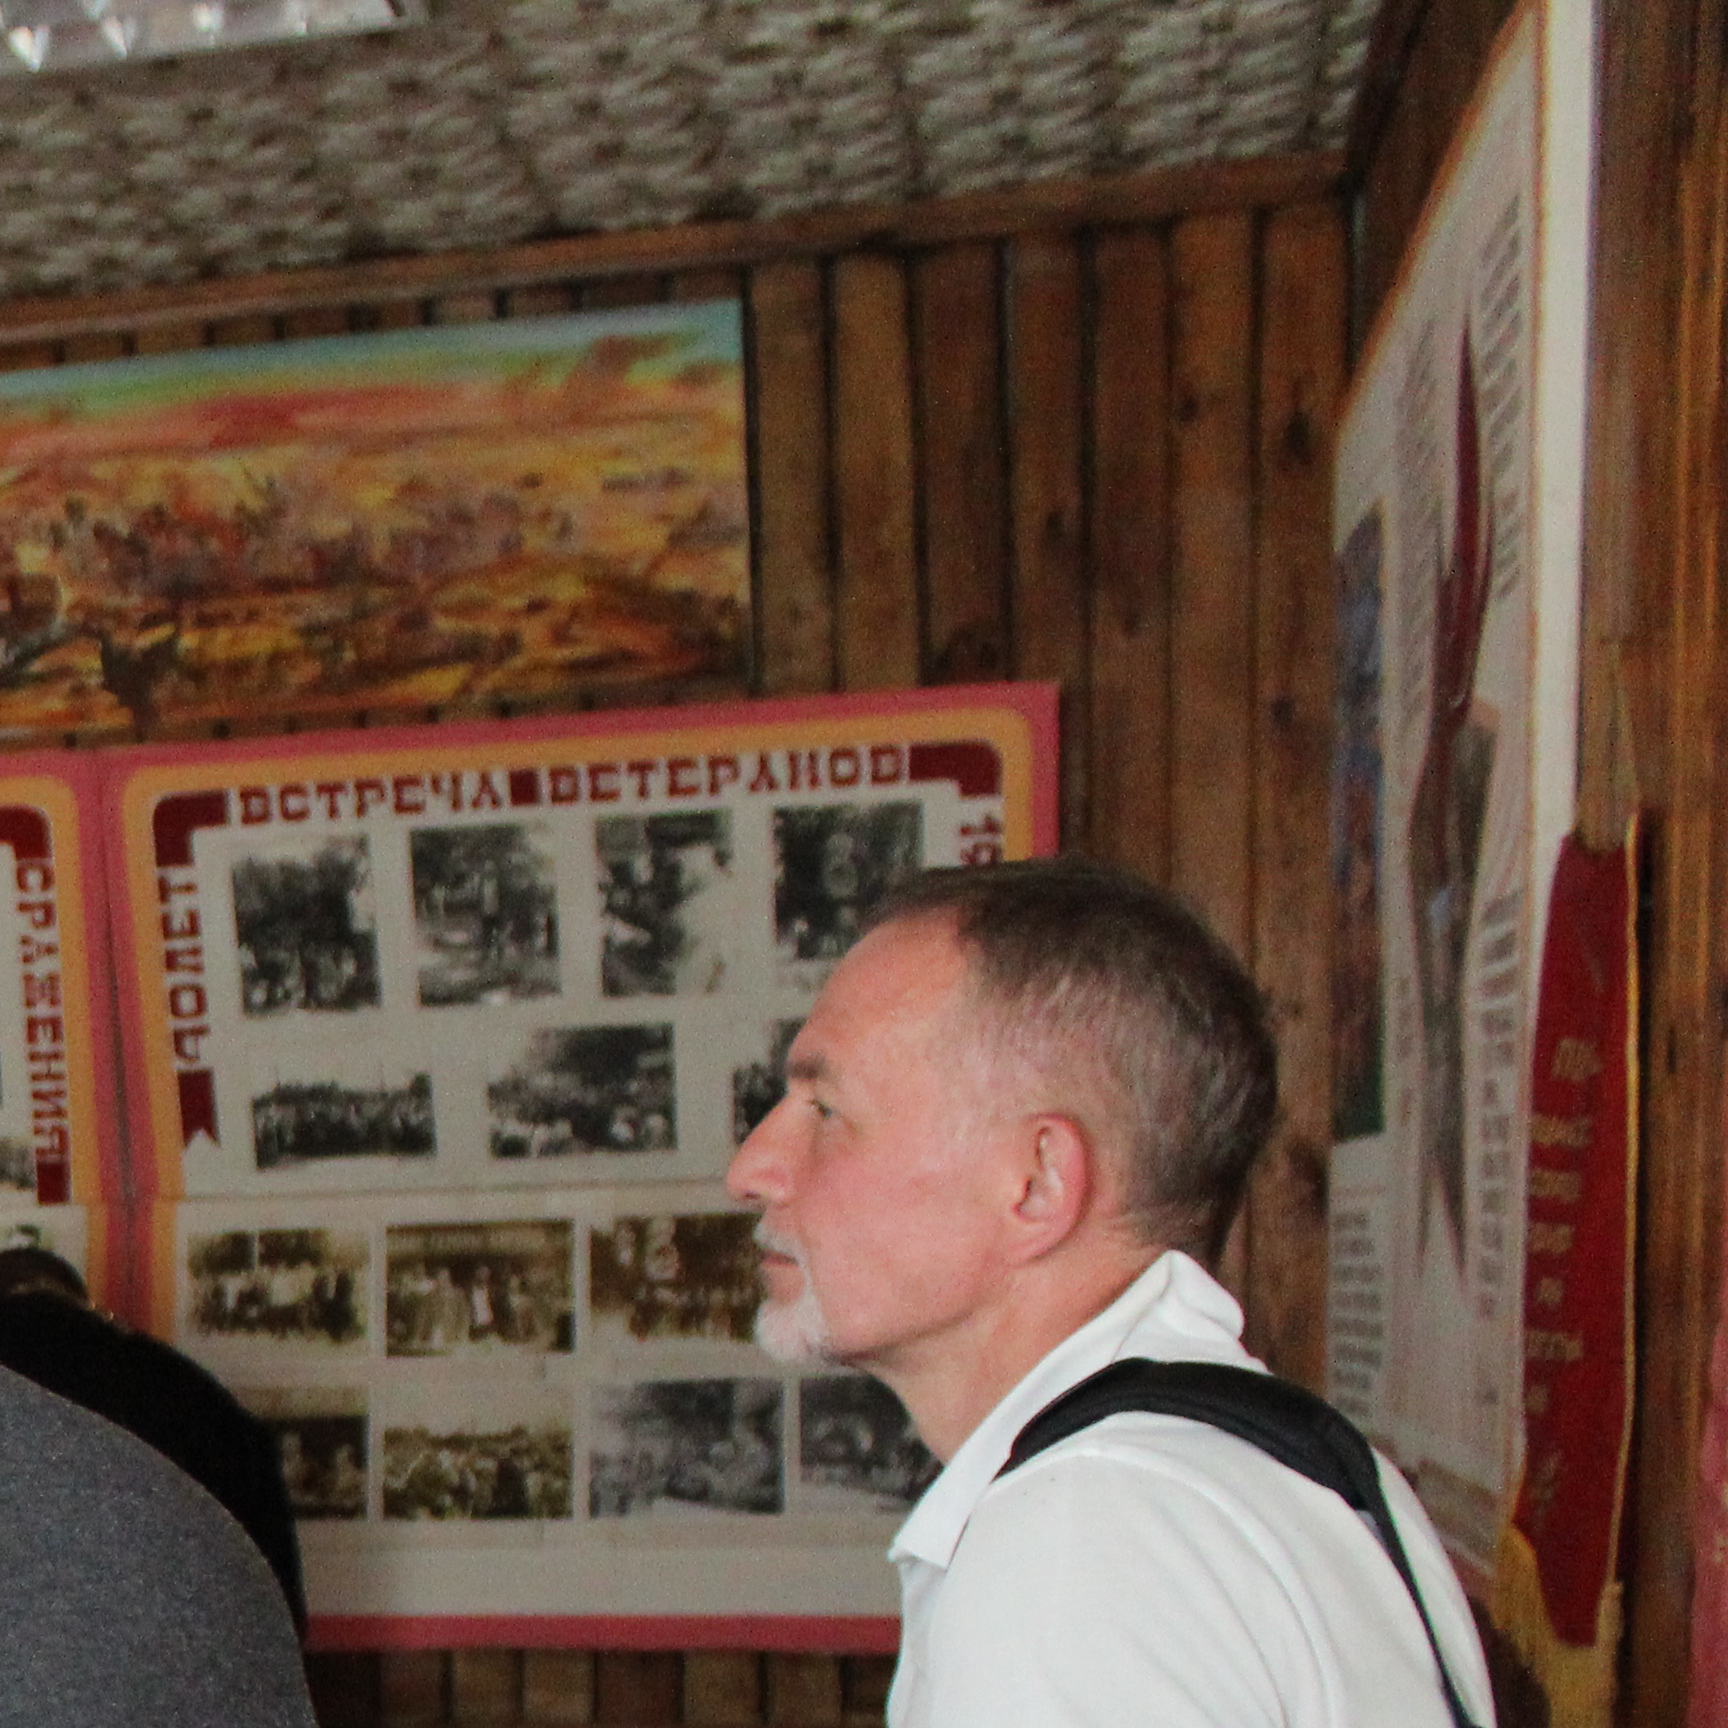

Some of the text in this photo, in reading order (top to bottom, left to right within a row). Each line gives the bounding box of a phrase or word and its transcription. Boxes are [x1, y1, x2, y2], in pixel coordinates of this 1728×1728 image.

[239, 771, 501, 824] ВСТРЕЧА
[548, 746, 902, 804] ВЕТЕРАНОВ
[15, 862, 68, 1161] СРАЖЕНИЯ
